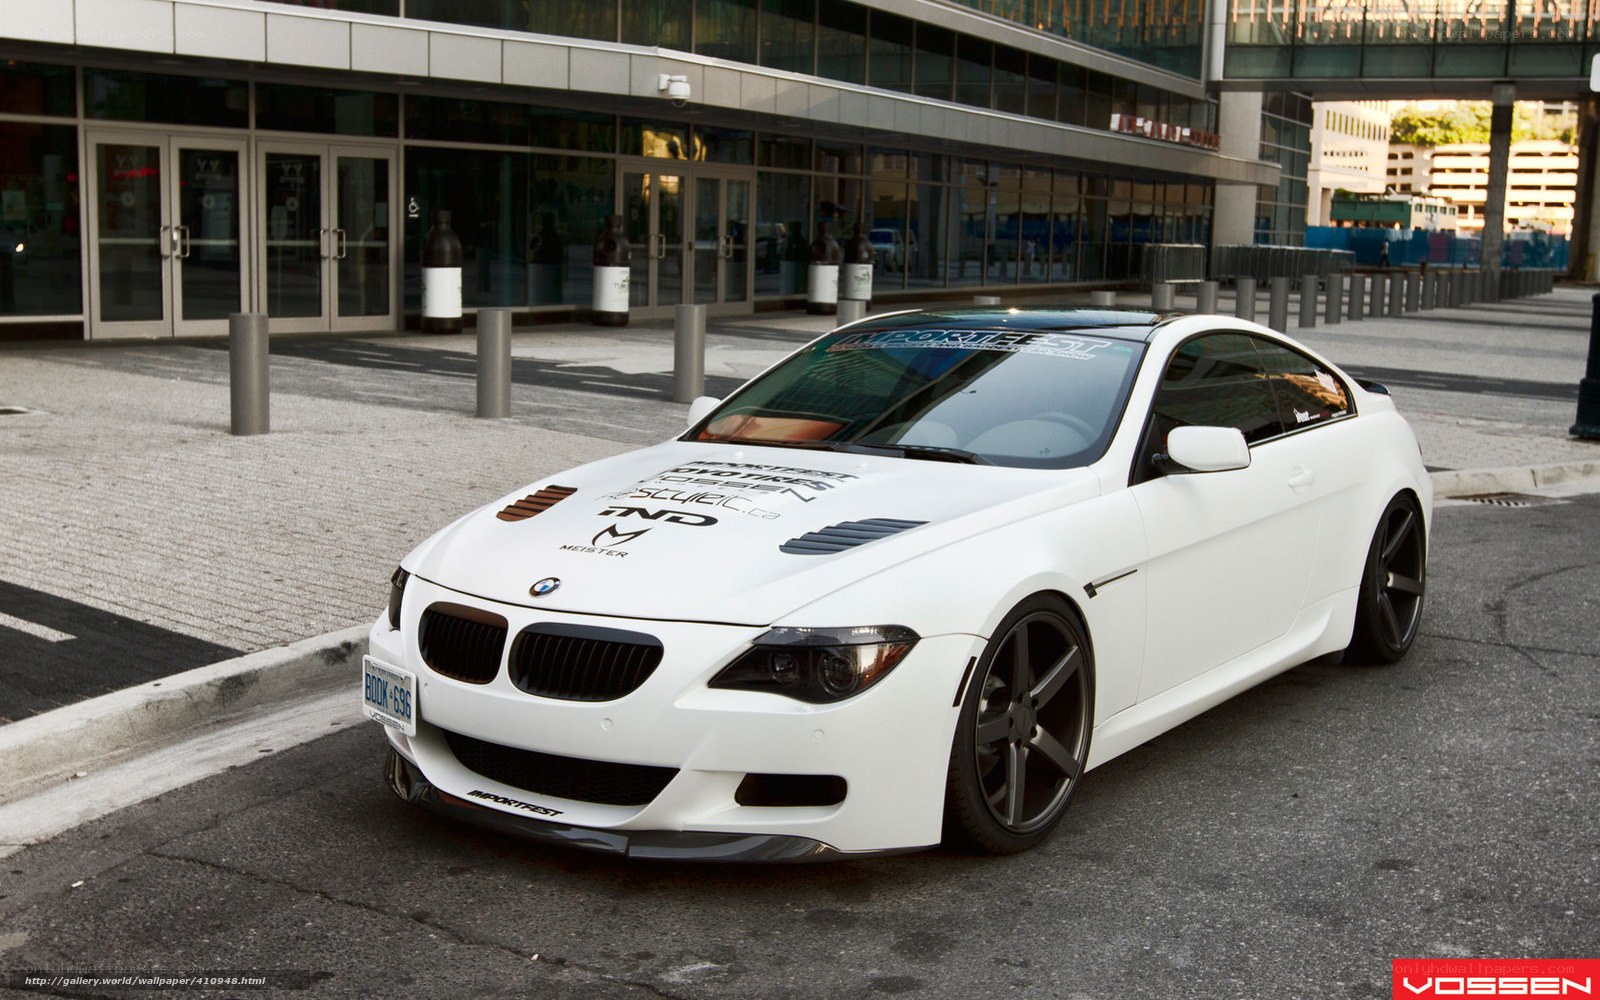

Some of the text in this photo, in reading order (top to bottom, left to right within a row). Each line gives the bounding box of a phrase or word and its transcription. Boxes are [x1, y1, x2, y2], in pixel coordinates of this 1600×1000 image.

[837, 330, 1112, 352] IMPORTFEST
[559, 544, 629, 558] MEISTER
[394, 684, 412, 719] 696
[369, 709, 404, 732] VOSSEN
[467, 790, 564, 818] IMPORTFEST
